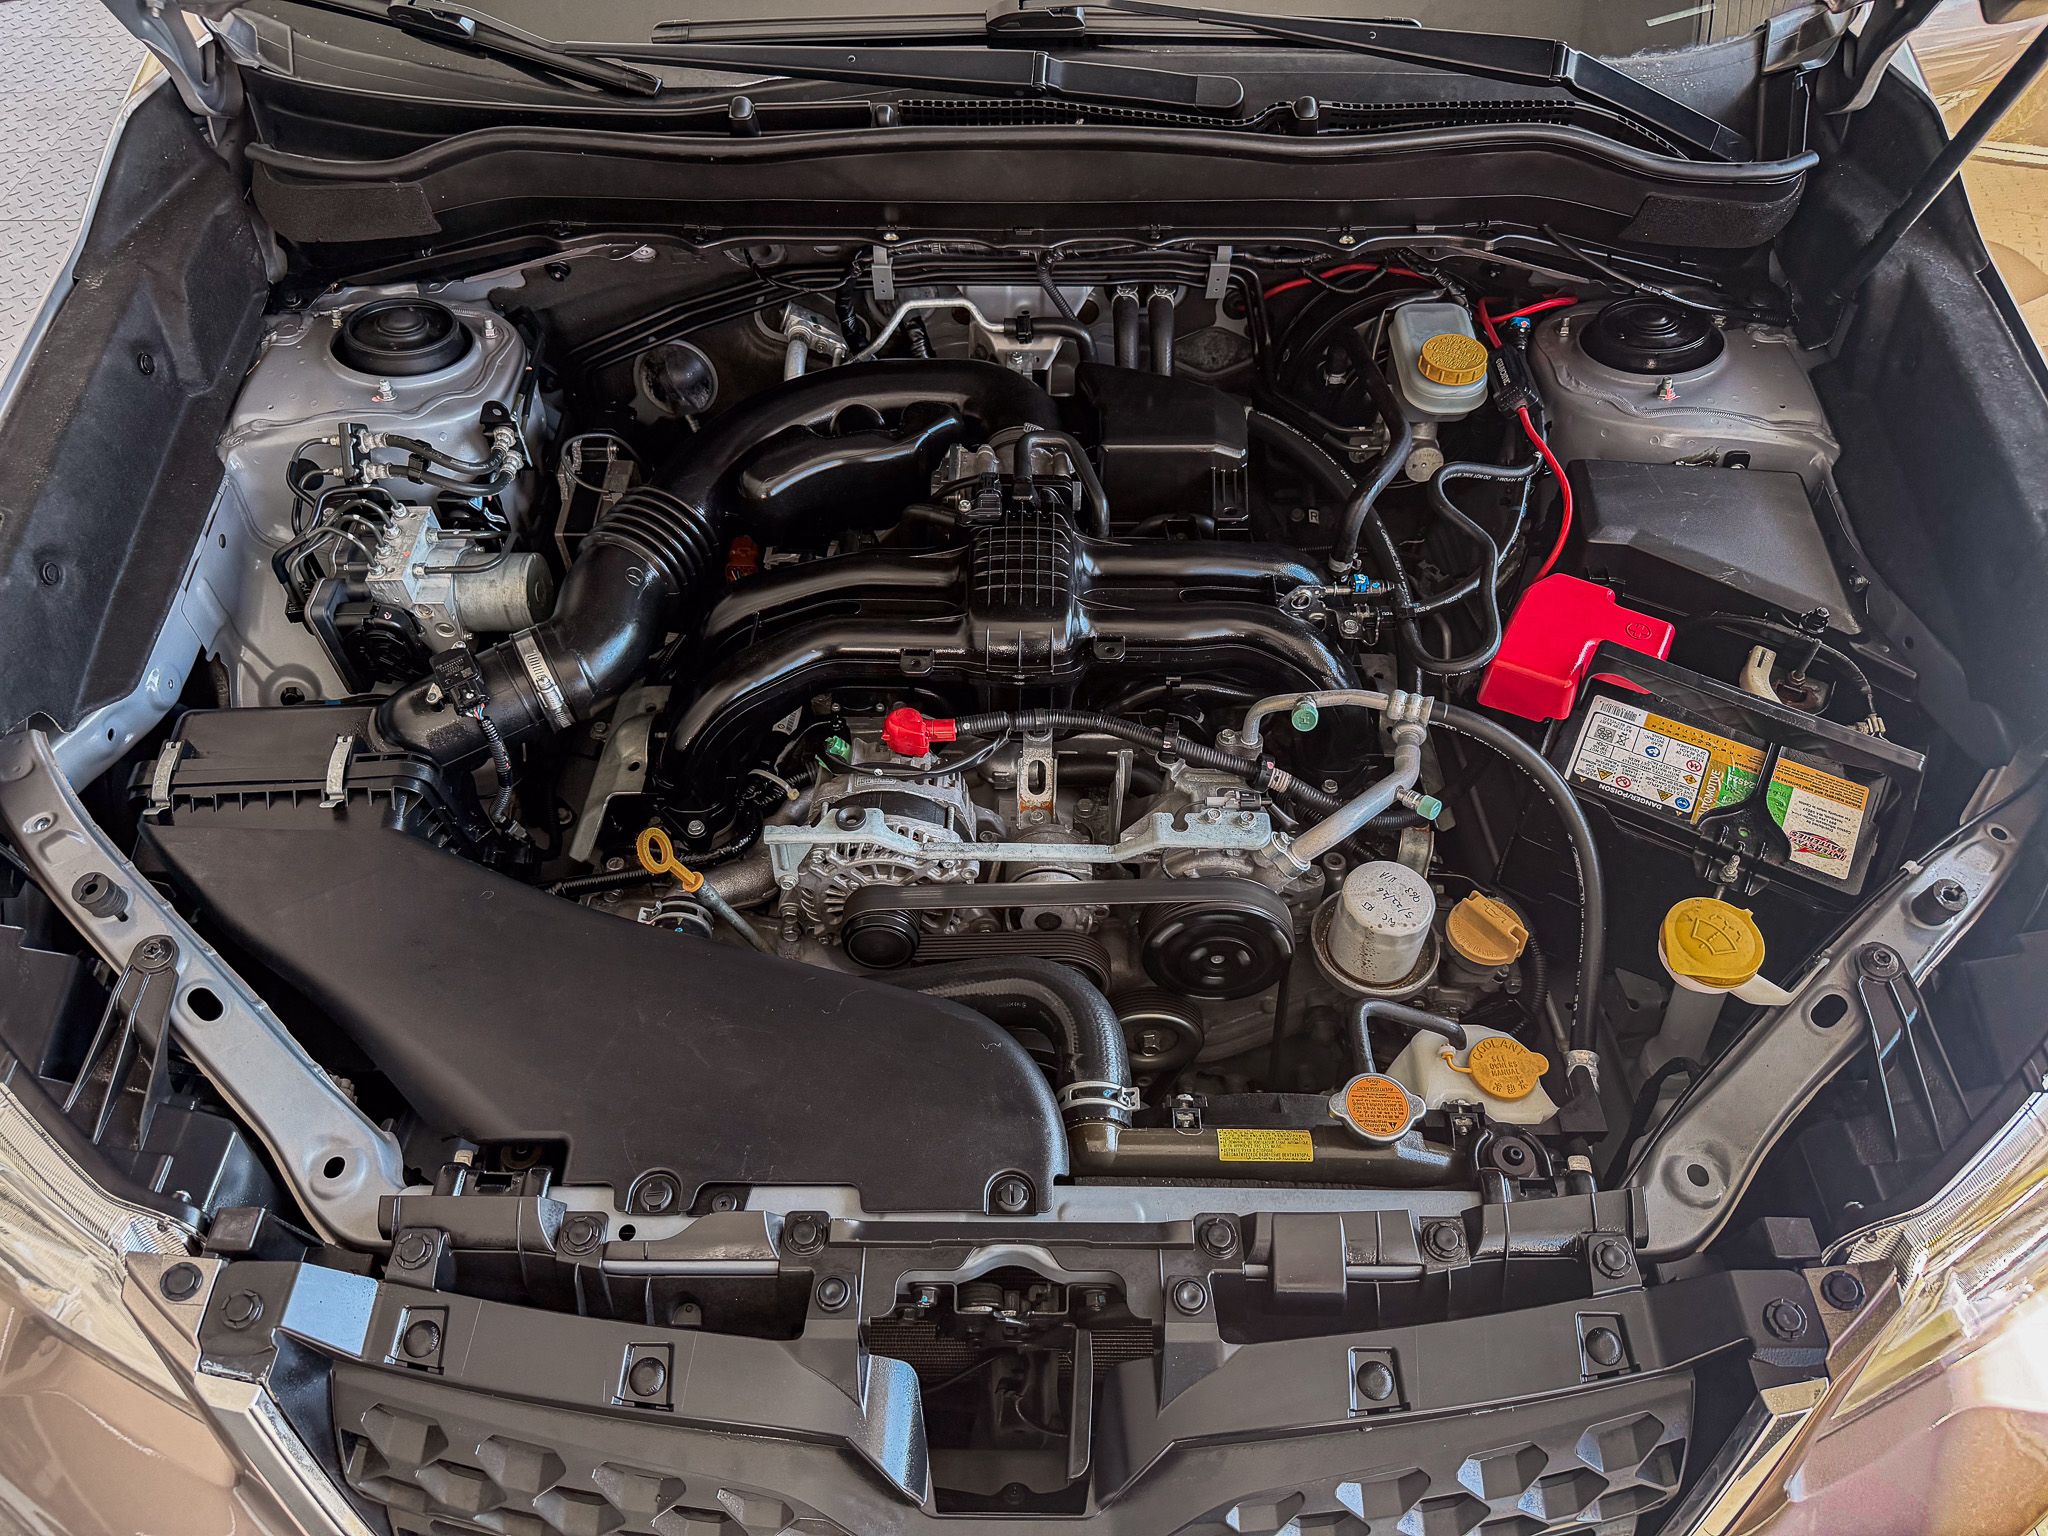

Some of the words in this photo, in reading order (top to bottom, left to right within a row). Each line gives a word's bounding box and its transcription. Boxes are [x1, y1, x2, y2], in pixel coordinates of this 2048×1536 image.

[1598, 783, 1662, 810] DANGER/POISON
[1788, 830, 1845, 853] BATTERIES
[1404, 887, 1421, 903] 963
[1472, 1036, 1527, 1064] COOLANT
[1491, 1054, 1505, 1063] SEE
[1491, 1066, 1520, 1078] MANUAL
